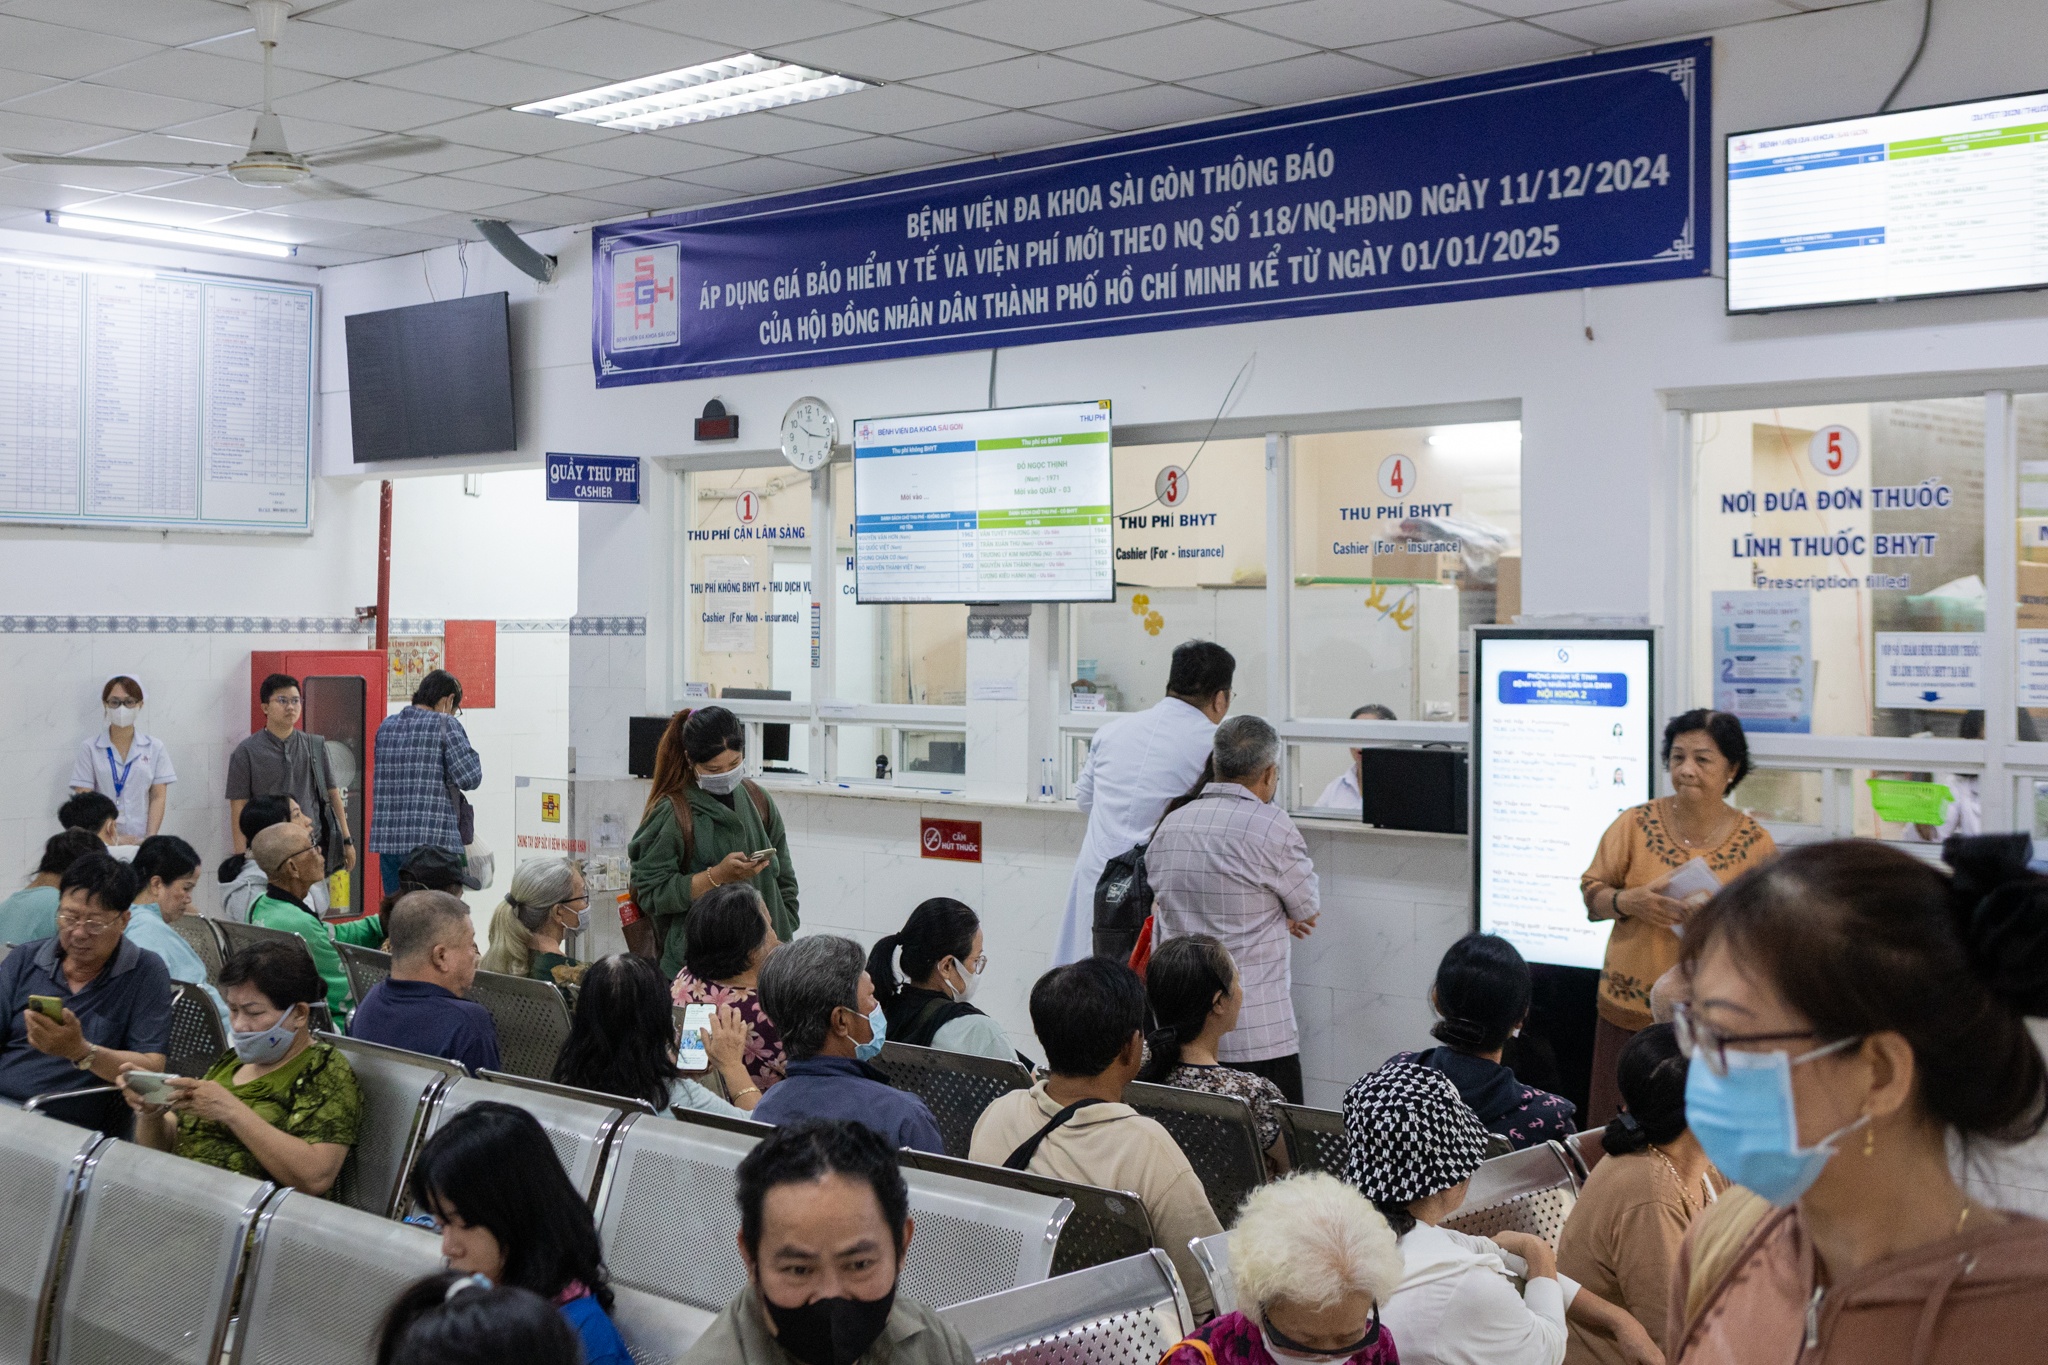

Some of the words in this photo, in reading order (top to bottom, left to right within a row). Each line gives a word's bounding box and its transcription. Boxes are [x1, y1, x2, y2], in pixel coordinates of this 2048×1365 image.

[907, 205, 957, 240] BỆNH
[963, 195, 1007, 233] VIỆN
[1013, 194, 1041, 223] ĐA
[1047, 185, 1102, 217] KHOA
[1109, 173, 1143, 208] SÀI
[1150, 166, 1194, 202] GÒN
[1201, 155, 1277, 194] THÔNG
[1286, 143, 1334, 182] BÁO
[699, 282, 721, 310] ÁP
[725, 279, 769, 312] DỤNG
[774, 268, 800, 300] GIÁ
[807, 261, 841, 296] BẢO
[847, 251, 891, 291] HIỂM
[897, 259, 908, 284] Y
[914, 245, 939, 282] TẾ
[944, 245, 968, 278] VÀ
[974, 239, 1019, 277] VIỆN
[1026, 231, 1059, 267] PHÍ
[1066, 226, 1103, 262] MỚI
[1110, 223, 1167, 256] THEO
[1174, 218, 1203, 250] NQ
[1210, 201, 1242, 243] SỐ
[1249, 190, 1412, 239] 118/NQ-HĐND
[1422, 174, 1489, 216] NGÀY
[1500, 154, 1670, 206] 11/12/2024
[759, 310, 792, 345] CỦA
[798, 309, 826, 346] HỘI
[832, 300, 879, 337] ĐỒNG
[885, 296, 933, 330] NHÂN
[939, 291, 977, 324] DÂN
[983, 284, 1048, 320] THÀNH
[1056, 270, 1099, 311] PHỐ
[1105, 265, 1133, 305] HỒ
[1141, 264, 1177, 301] CHÍ
[1185, 263, 1240, 296] MINH
[1250, 244, 1281, 289] KỂ
[1288, 247, 1321, 284] TỪ
[1329, 240, 1392, 281] NGÀY
[1402, 225, 1560, 273] 01/01/2025
[797, 410, 803, 419] 11
[805, 405, 812, 414] 12
[816, 408, 819, 416] 1
[791, 420, 798, 429] 10
[822, 415, 827, 424] 2
[789, 433, 794, 441] 9
[826, 428, 831, 437] 3
[793, 445, 797, 454] 8
[824, 441, 828, 449] 4
[1827, 432, 1843, 470] 5
[801, 453, 805, 462] 7
[809, 455, 813, 464] 6
[817, 451, 822, 459] 5
[550, 457, 584, 483] QUẦY
[586, 465, 612, 482] THU
[615, 463, 636, 483] PHÍ
[1027, 461, 1045, 471] NGỌC
[1025, 475, 1040, 483] (Nam)
[1390, 460, 1403, 492] 4
[574, 485, 612, 498] CASHIER
[1166, 470, 1178, 503] 3
[1721, 491, 1756, 513] NƠI
[1765, 488, 1808, 512] ĐƯA
[1817, 486, 1862, 510] ĐƠN
[1871, 477, 1952, 509] THUỐC
[743, 494, 752, 520] 1
[1339, 507, 1371, 521] THU
[1376, 501, 1403, 519] PHÍ
[1409, 503, 1453, 518] BHYT
[1119, 516, 1147, 530] THU
[1151, 511, 1175, 529] PHÍ
[1179, 513, 1217, 527] BHYT
[687, 530, 710, 541] THU
[711, 527, 730, 540] PHÍ
[733, 525, 752, 542] CẬN
[756, 524, 777, 539] LÂM
[779, 523, 805, 539] SÀNG
[1333, 541, 1369, 556] Cashier
[1374, 540, 1395, 556] (For
[1407, 538, 1462, 554] insurance)
[1732, 533, 1782, 558] LĨNH
[1790, 528, 1866, 557] THUỐC
[1875, 534, 1937, 555] BHYT
[1115, 546, 1148, 560] Cashier
[1150, 545, 1168, 561] (For
[1178, 544, 1225, 559] insurance)
[690, 583, 703, 594] THU
[705, 580, 716, 593] PHÍ
[717, 580, 741, 593] KHÔNG
[742, 581, 760, 592] BHYT
[769, 581, 783, 592] THU
[784, 581, 801, 595] DỊCH
[1757, 575, 1859, 592] Prescription
[1865, 574, 1910, 589] filled
[702, 612, 725, 623] Cashier
[729, 612, 743, 623] (For
[745, 612, 758, 622] Non
[764, 611, 800, 623] insurance)
[1580, 690, 1587, 699] 2
[952, 831, 967, 842] CẤM
[941, 841, 954, 850] HÚT
[956, 842, 978, 852] THUỐC
